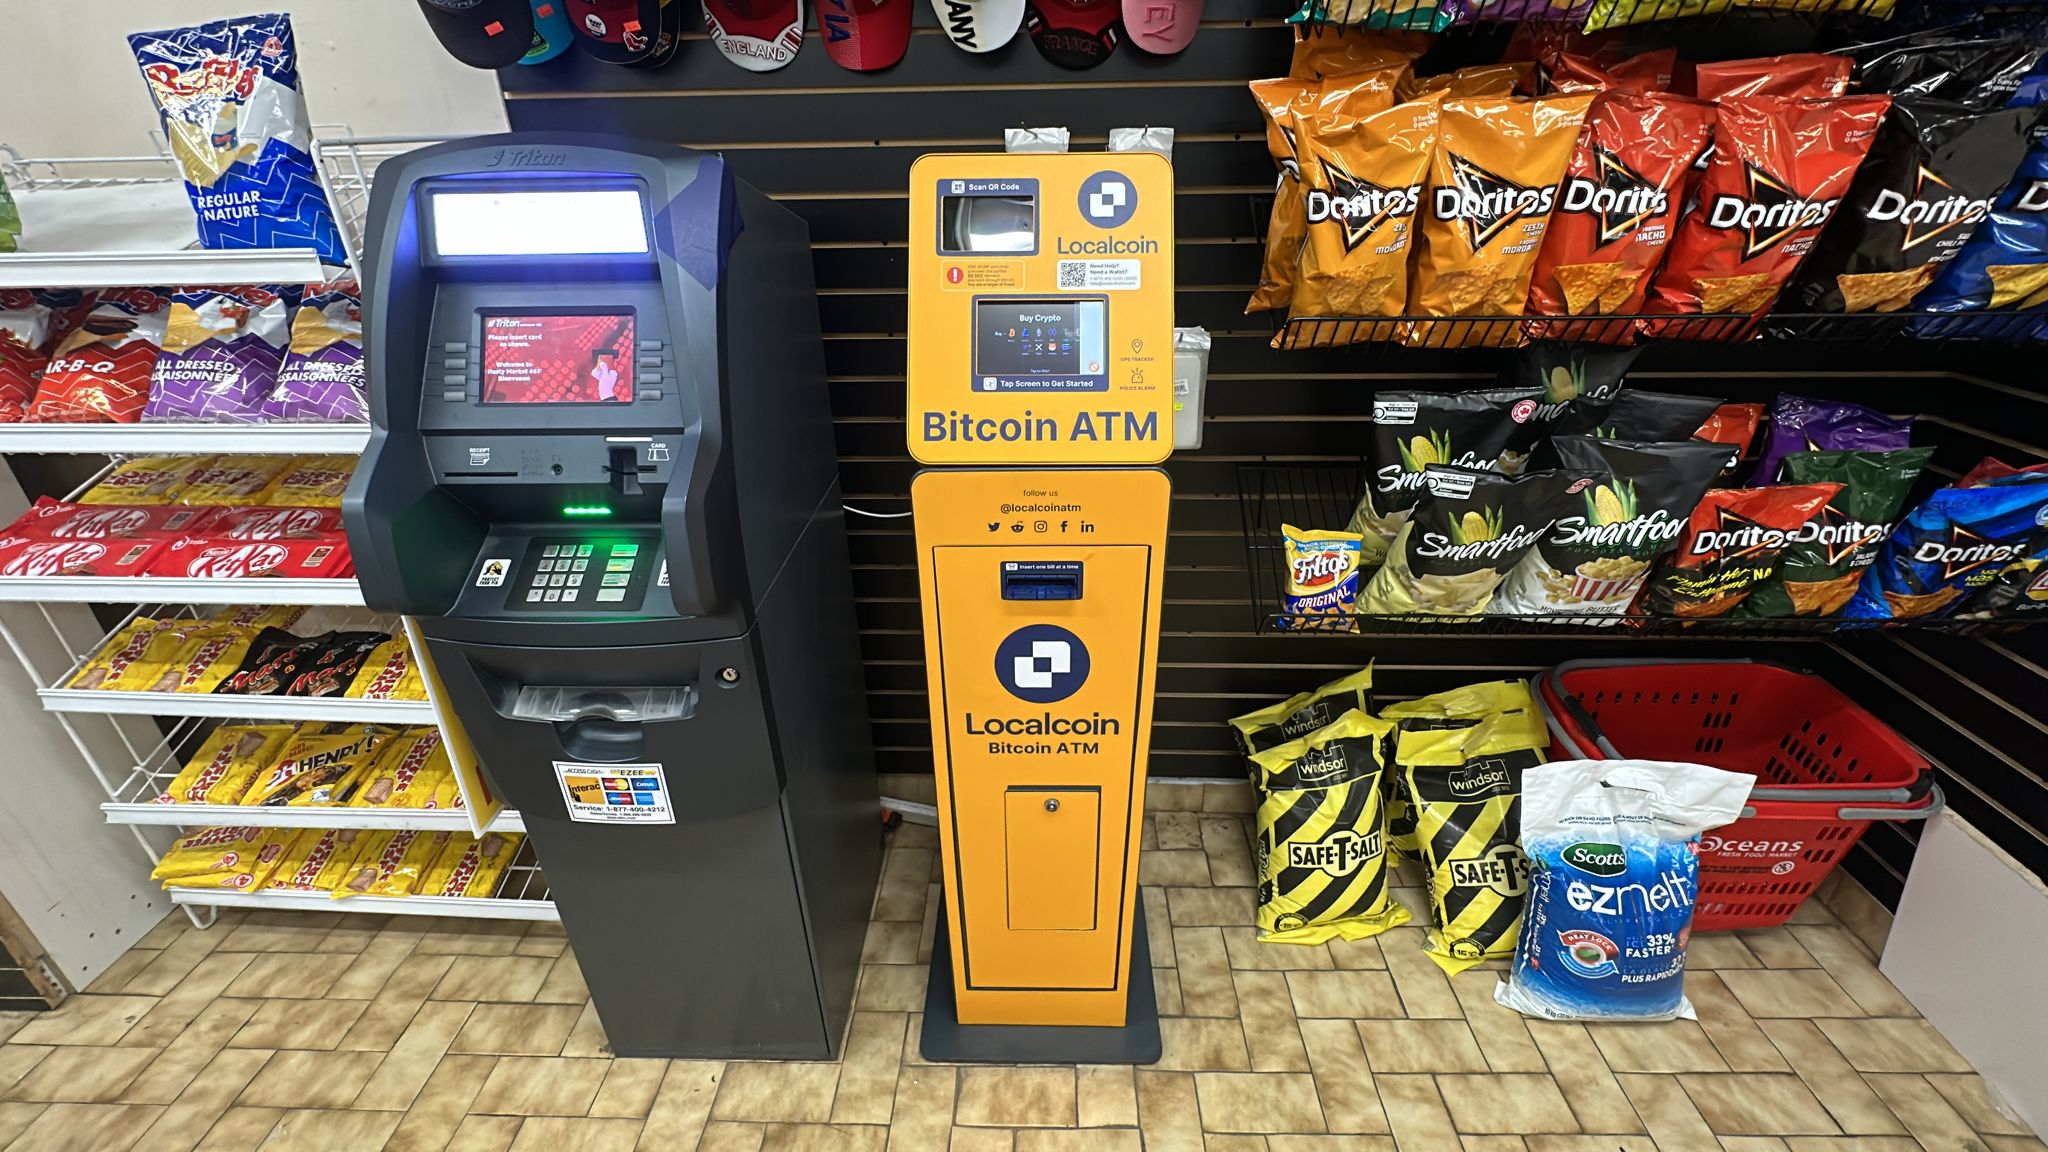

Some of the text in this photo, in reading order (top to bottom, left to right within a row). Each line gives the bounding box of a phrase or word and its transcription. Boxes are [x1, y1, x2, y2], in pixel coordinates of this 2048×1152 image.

[721, 38, 786, 62] ENGLAND
[509, 150, 566, 167] Triton
[988, 183, 1000, 191] QR
[198, 191, 261, 208] REGULAR
[1307, 185, 1422, 223] Doritos
[1435, 184, 1558, 220] Doritos
[203, 206, 260, 221] NATURE
[1709, 196, 1838, 229] Doritos
[1522, 222, 1544, 232] ZESTY
[1636, 230, 1666, 242] NACHO
[1057, 235, 1158, 255] Localcoin
[495, 319, 521, 327] Triton
[1020, 314, 1062, 324] Buy Crypto
[155, 360, 236, 371] ALL DRESSED
[1000, 379, 1014, 388] Tap
[1016, 379, 1040, 387] Screen
[1051, 379, 1064, 387] Get
[1066, 379, 1093, 387] Started
[923, 410, 1158, 442] Bitcoin ATM
[1023, 489, 1047, 497] follow
[1000, 503, 1081, 514] @localcoinatm
[1416, 518, 1556, 561] Smartfood
[1692, 525, 1800, 555] Doritos
[1794, 521, 1893, 545] Doritos
[1913, 541, 2028, 563] Doritos
[1298, 585, 1351, 608] ORIGINAL
[965, 712, 1120, 736] Localcoin
[989, 742, 1099, 754] Bitcoin ATM
[1300, 758, 1344, 775] windsor
[568, 783, 600, 792] Interac
[1452, 769, 1505, 791] windsor
[1292, 834, 1381, 871] SAFE-T-SALT
[1572, 848, 1625, 866] Scotts
[1455, 852, 1529, 890] SAFE-T-S
[1568, 934, 1612, 951] HEAT LOCK
[1646, 932, 1676, 947] 33%
[1622, 974, 1644, 983] PLUS
